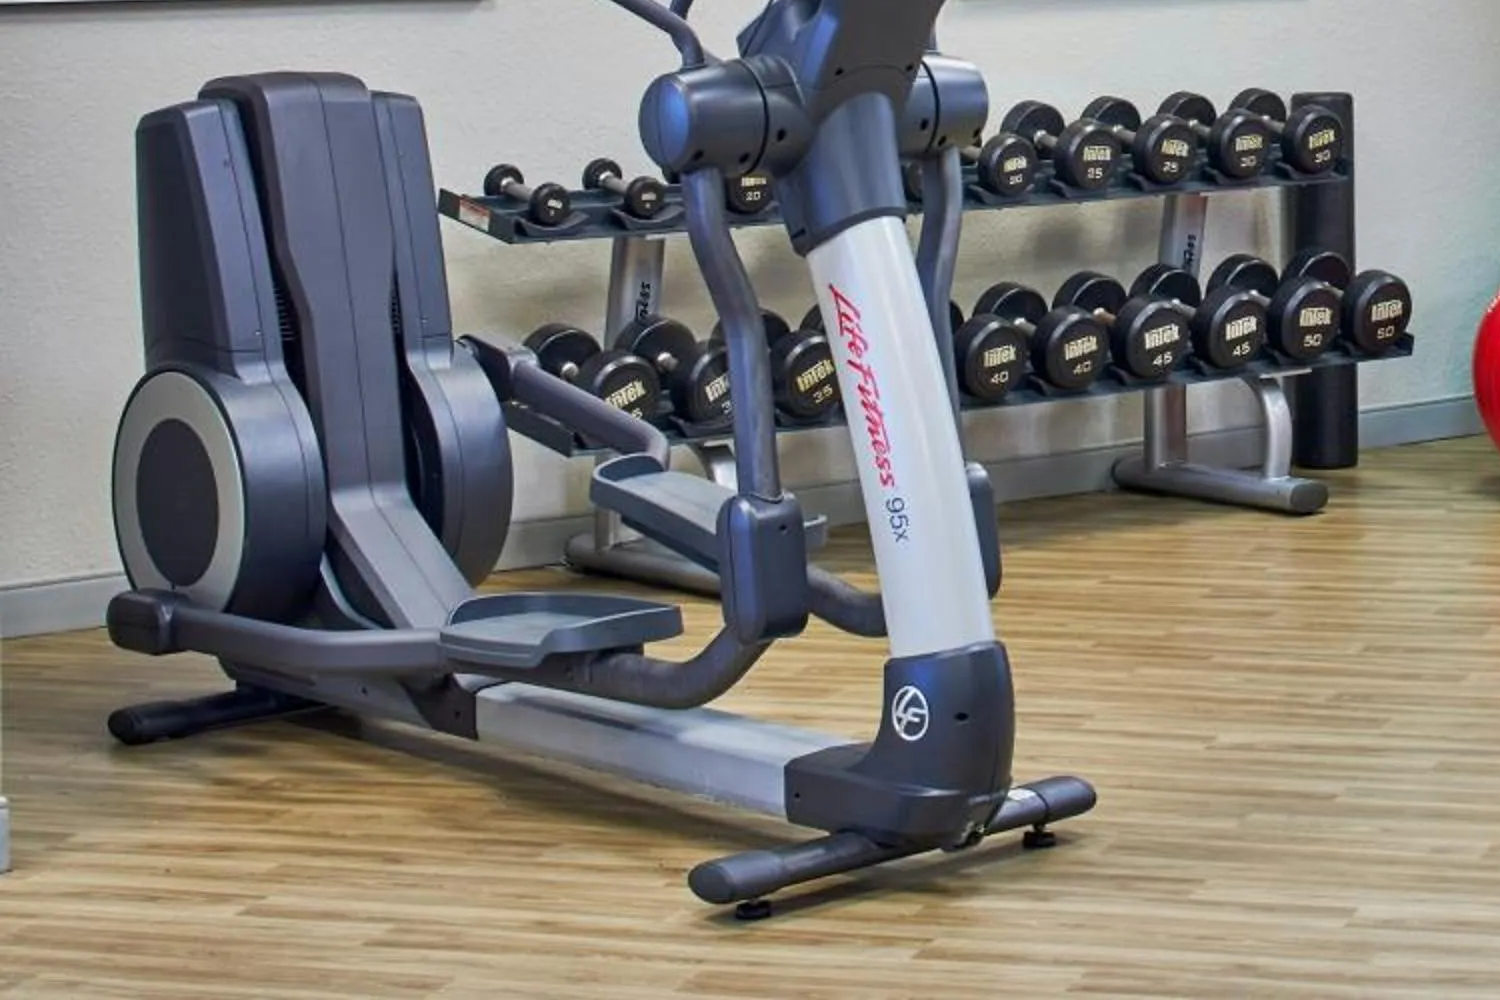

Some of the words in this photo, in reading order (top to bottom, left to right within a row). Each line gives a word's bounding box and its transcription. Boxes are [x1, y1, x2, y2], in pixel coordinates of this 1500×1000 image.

[1377, 325, 1395, 340] 50
[1303, 333, 1323, 348] 50
[1232, 342, 1251, 357] 45
[1153, 351, 1173, 367] 45
[1073, 360, 1092, 375] 40
[990, 371, 1009, 385] 40
[813, 384, 833, 404] 35
